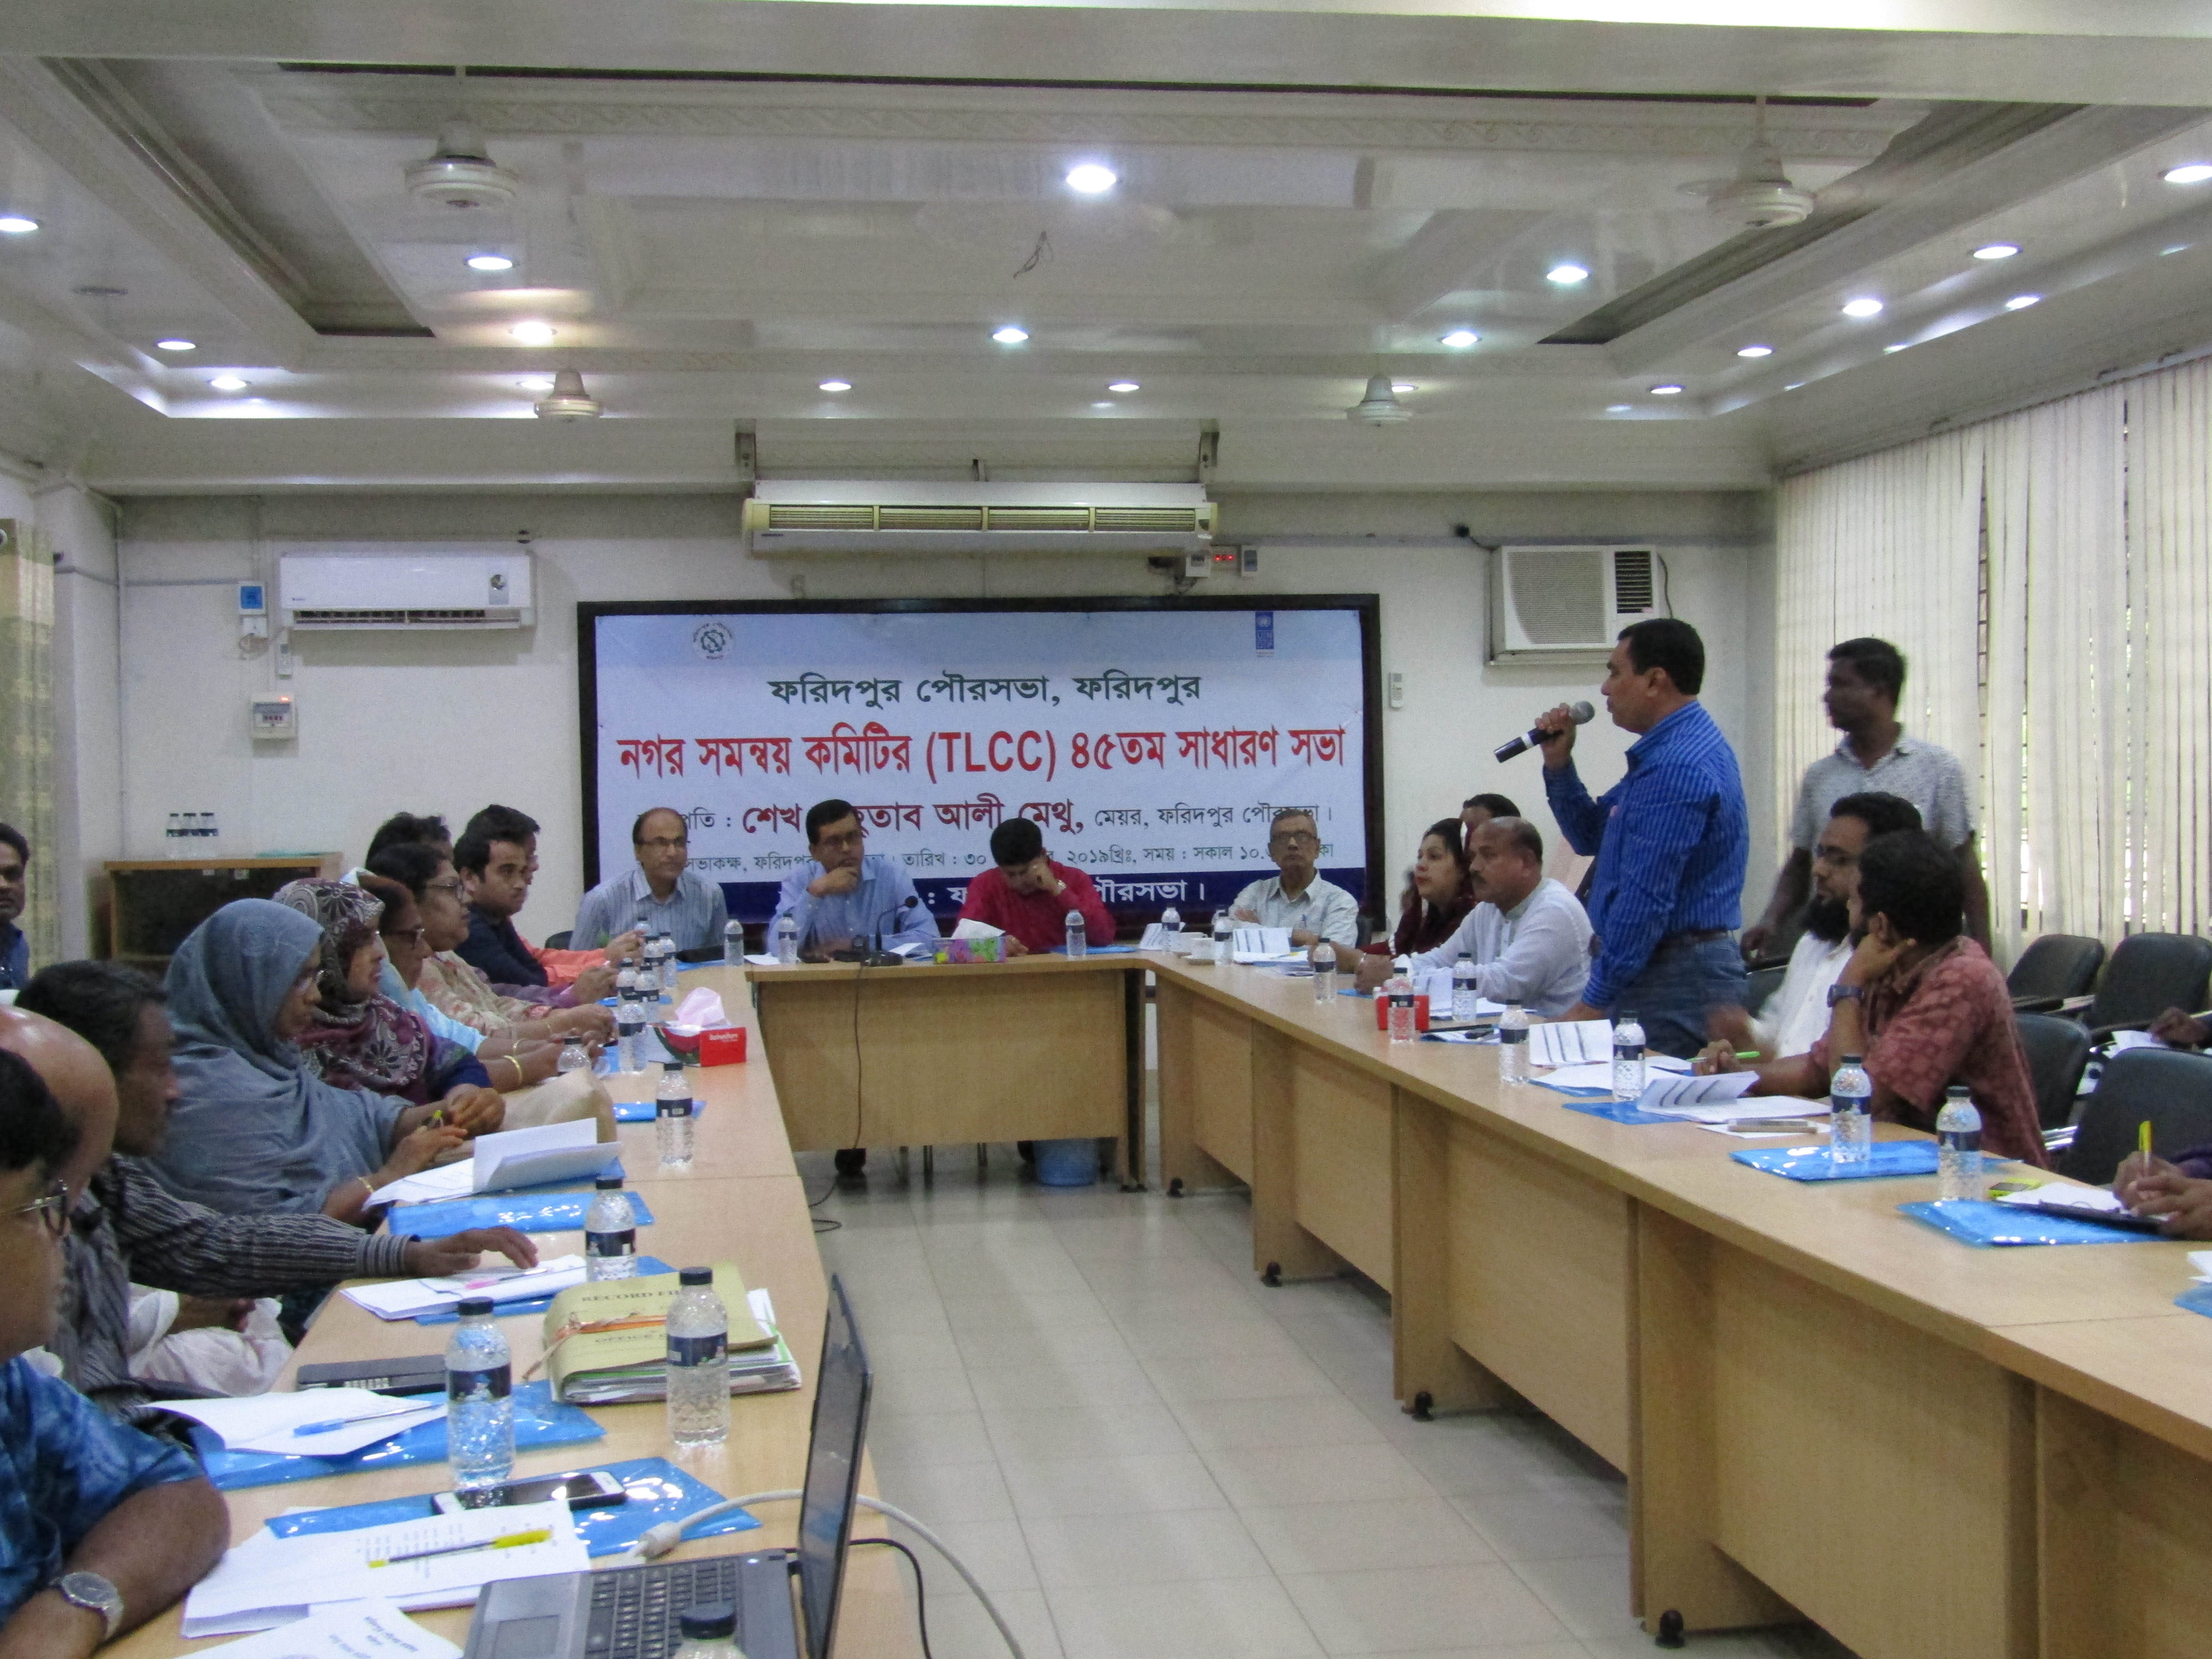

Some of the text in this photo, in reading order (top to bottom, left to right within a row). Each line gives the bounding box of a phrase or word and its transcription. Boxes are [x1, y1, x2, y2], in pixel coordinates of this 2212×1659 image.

[767, 668, 1201, 709] ফরিদপুর পৌরসভা, ফরিদপুর
[617, 722, 1346, 784] নগর সমন্বয় কমিটির (TLCC) ৪৫তম সাধারণ সভা
[743, 803, 803, 833] শেখ
[933, 793, 1005, 830] আলী
[1095, 809, 1149, 828] মেয়র,
[1157, 802, 1234, 828] ফরিদপুর
[902, 848, 945, 866] তারিখ
[1143, 848, 1175, 861] সময়
[1194, 846, 1233, 860] সকাল
